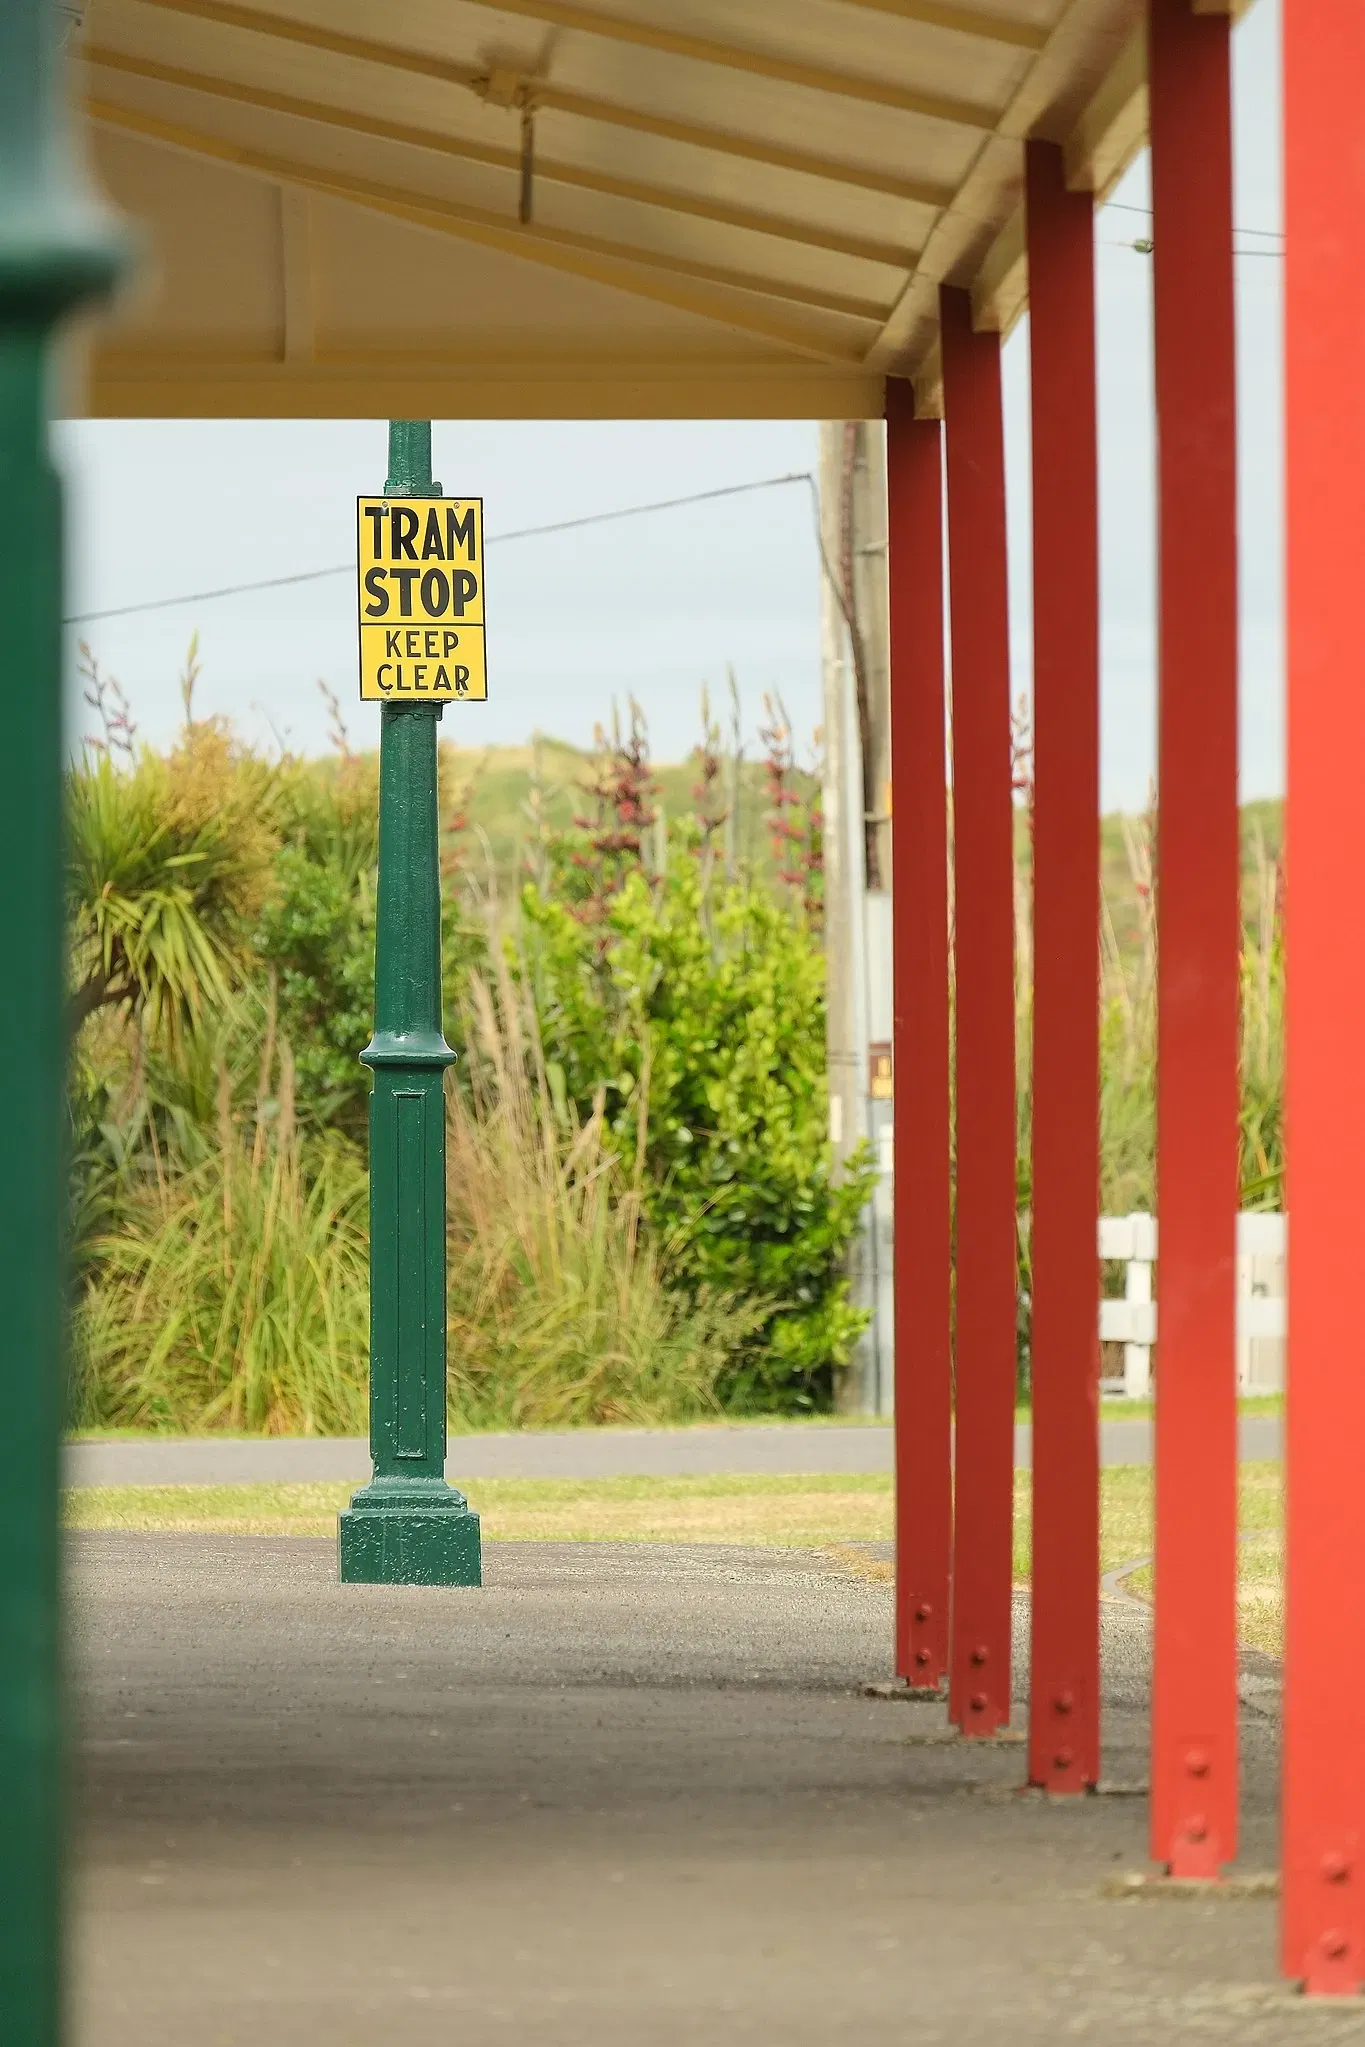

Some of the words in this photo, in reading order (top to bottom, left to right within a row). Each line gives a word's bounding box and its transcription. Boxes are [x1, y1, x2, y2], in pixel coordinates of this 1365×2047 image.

[364, 506, 476, 561] TRAM
[364, 566, 478, 617] STOP
[385, 630, 459, 658] KEEP
[376, 664, 470, 691] CLEAR
